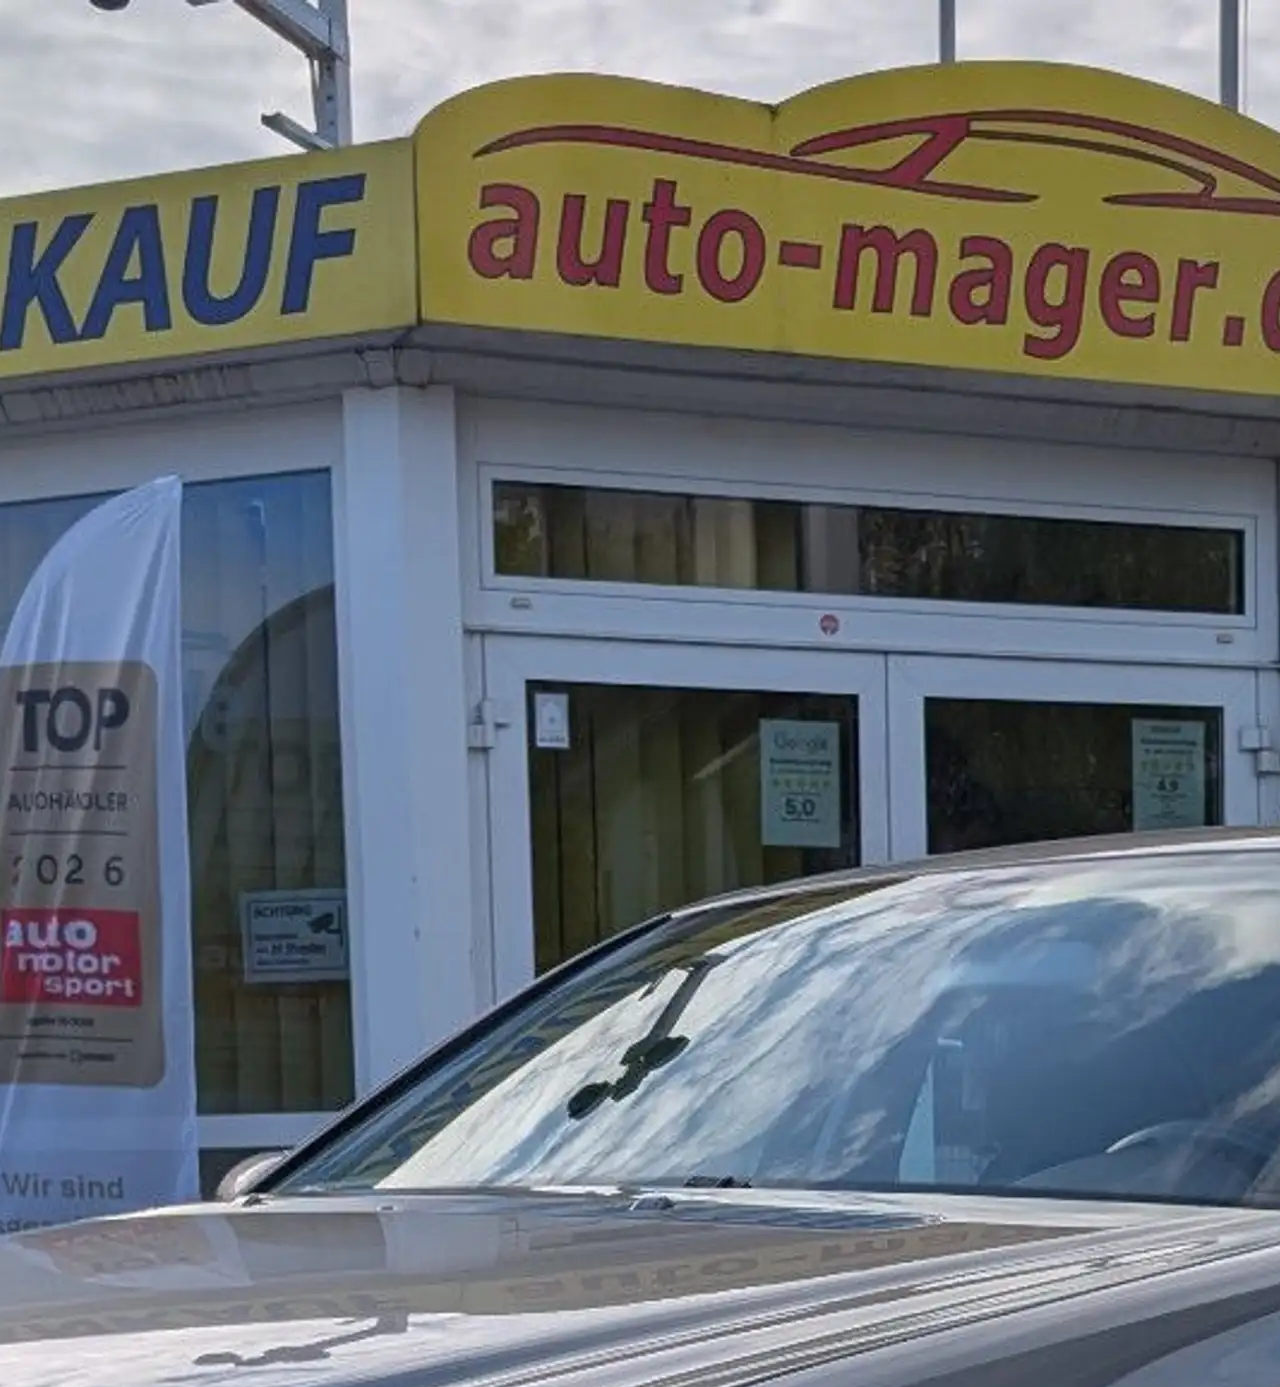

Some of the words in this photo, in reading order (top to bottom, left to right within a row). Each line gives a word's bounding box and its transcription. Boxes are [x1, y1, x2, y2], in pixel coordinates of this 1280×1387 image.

[17, 686, 130, 752] TOP
[45, 976, 136, 998] sport
[1, 1171, 55, 1198] Wir
[60, 1174, 125, 1200] sind
